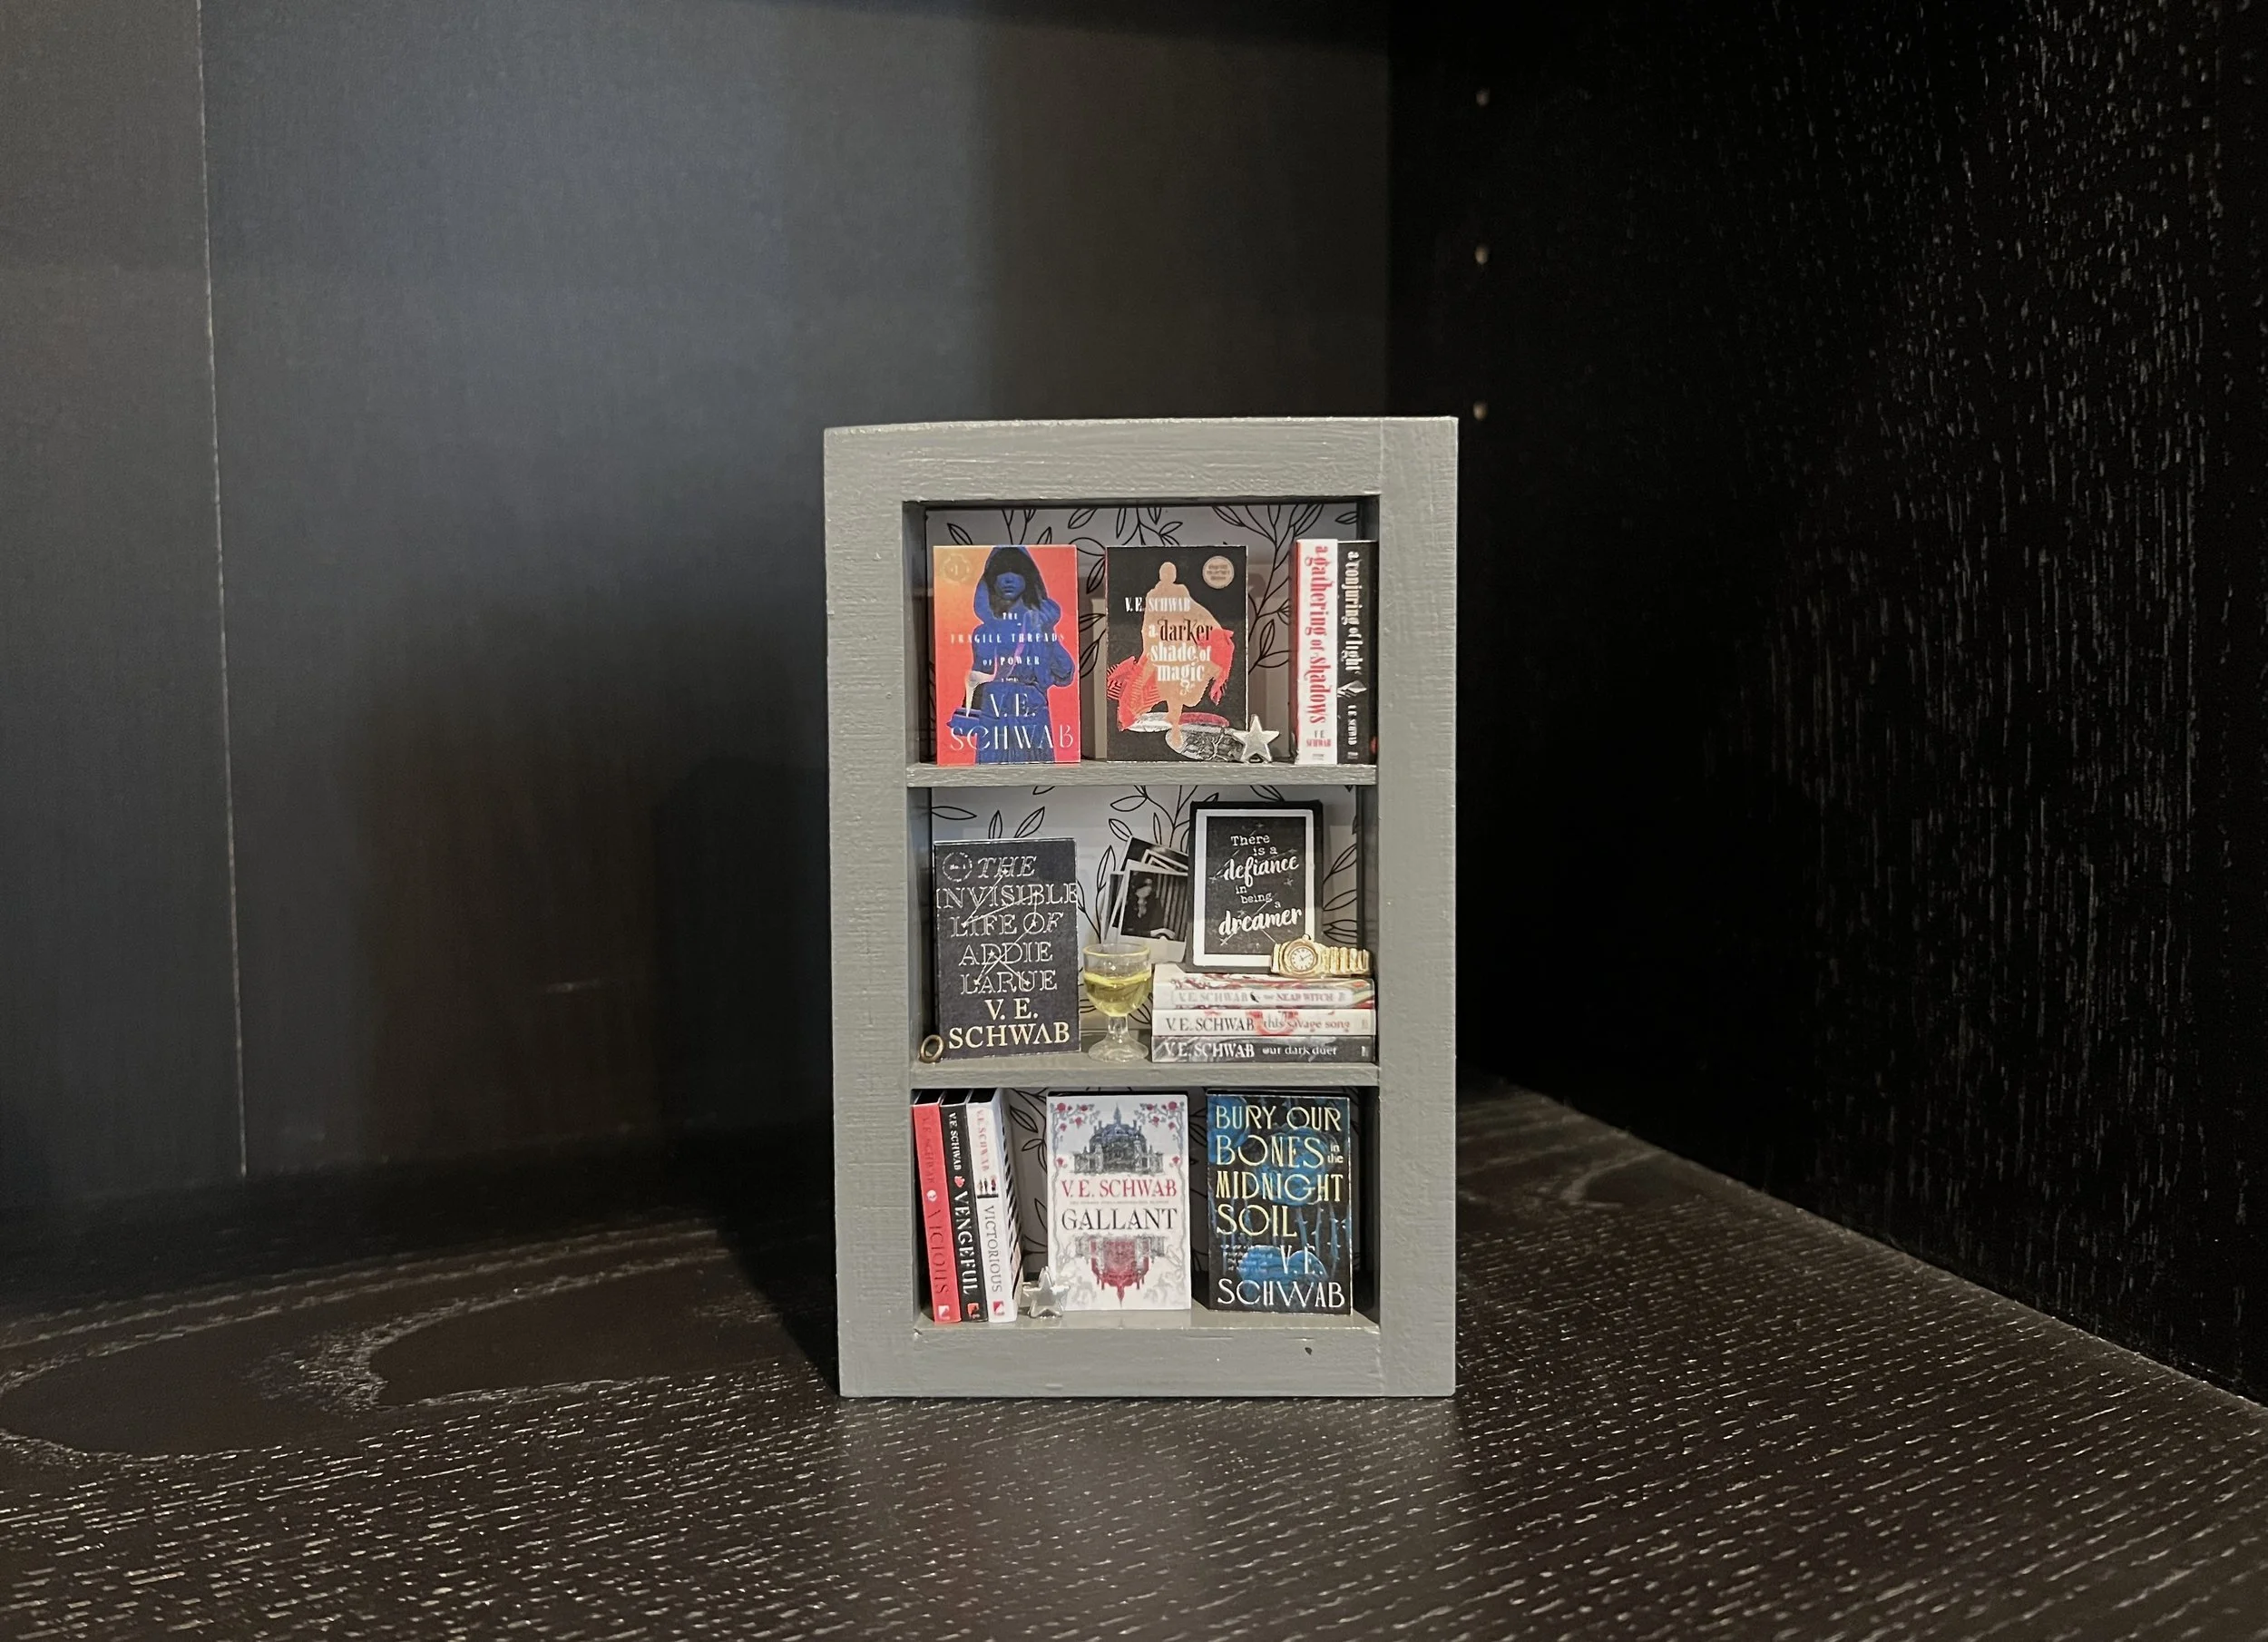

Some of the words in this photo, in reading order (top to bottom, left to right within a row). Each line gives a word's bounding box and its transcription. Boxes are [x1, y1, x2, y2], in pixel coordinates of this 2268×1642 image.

[1148, 597, 1191, 612] SCHWAB
[1305, 557, 1333, 636] gathering
[1342, 561, 1362, 626] conjuring
[1148, 623, 1156, 638] a
[1158, 615, 1213, 644] darker
[1348, 627, 1362, 638] of
[1149, 642, 1198, 662] shade
[1199, 645, 1212, 661] of
[1310, 640, 1325, 650] of
[1342, 640, 1364, 670] light
[1000, 656, 1040, 665] POWER
[1156, 662, 1205, 695] magic
[1304, 656, 1331, 723] shadows
[950, 725, 1074, 750] SCHWAB
[1230, 835, 1270, 845] There
[1253, 846, 1266, 855] is
[1270, 846, 1277, 855] a
[977, 855, 1037, 878] THE
[1223, 855, 1299, 887] defiance
[936, 883, 1078, 908] INVISIBLE
[1236, 885, 1247, 894] in
[1240, 892, 1273, 904] being
[950, 914, 1017, 937] LIFE
[1023, 912, 1064, 935] OF
[1218, 907, 1302, 935] dreamer
[958, 942, 1053, 966] ADDIE
[960, 970, 1058, 994] LARUE
[1200, 992, 1248, 1002] SCHWAB
[948, 1021, 1070, 1050] SCHWAB
[1196, 1018, 1255, 1031] SCHWAB
[1325, 1020, 1350, 1032] song
[1194, 1042, 1255, 1057] SCHWAB
[1262, 1046, 1281, 1055] our
[1285, 1045, 1309, 1056] dark
[1311, 1046, 1337, 1055] duet
[1216, 1105, 1276, 1129] BURY
[1286, 1106, 1342, 1131] OUR
[951, 1130, 962, 1170] SCHWAB
[1216, 1134, 1325, 1168] BONES
[1327, 1153, 1344, 1163] the
[1330, 1143, 1340, 1152] in
[1100, 1178, 1178, 1197] SCHWAB
[1216, 1170, 1344, 1205] MIDNIGHT
[1061, 1207, 1178, 1230] GALLANT
[1217, 1203, 1297, 1236] SOIL
[954, 1190, 978, 1295] VENGEFUL
[984, 1206, 1002, 1293] VICTORIOUS
[1217, 1277, 1345, 1308] SCHWAB
